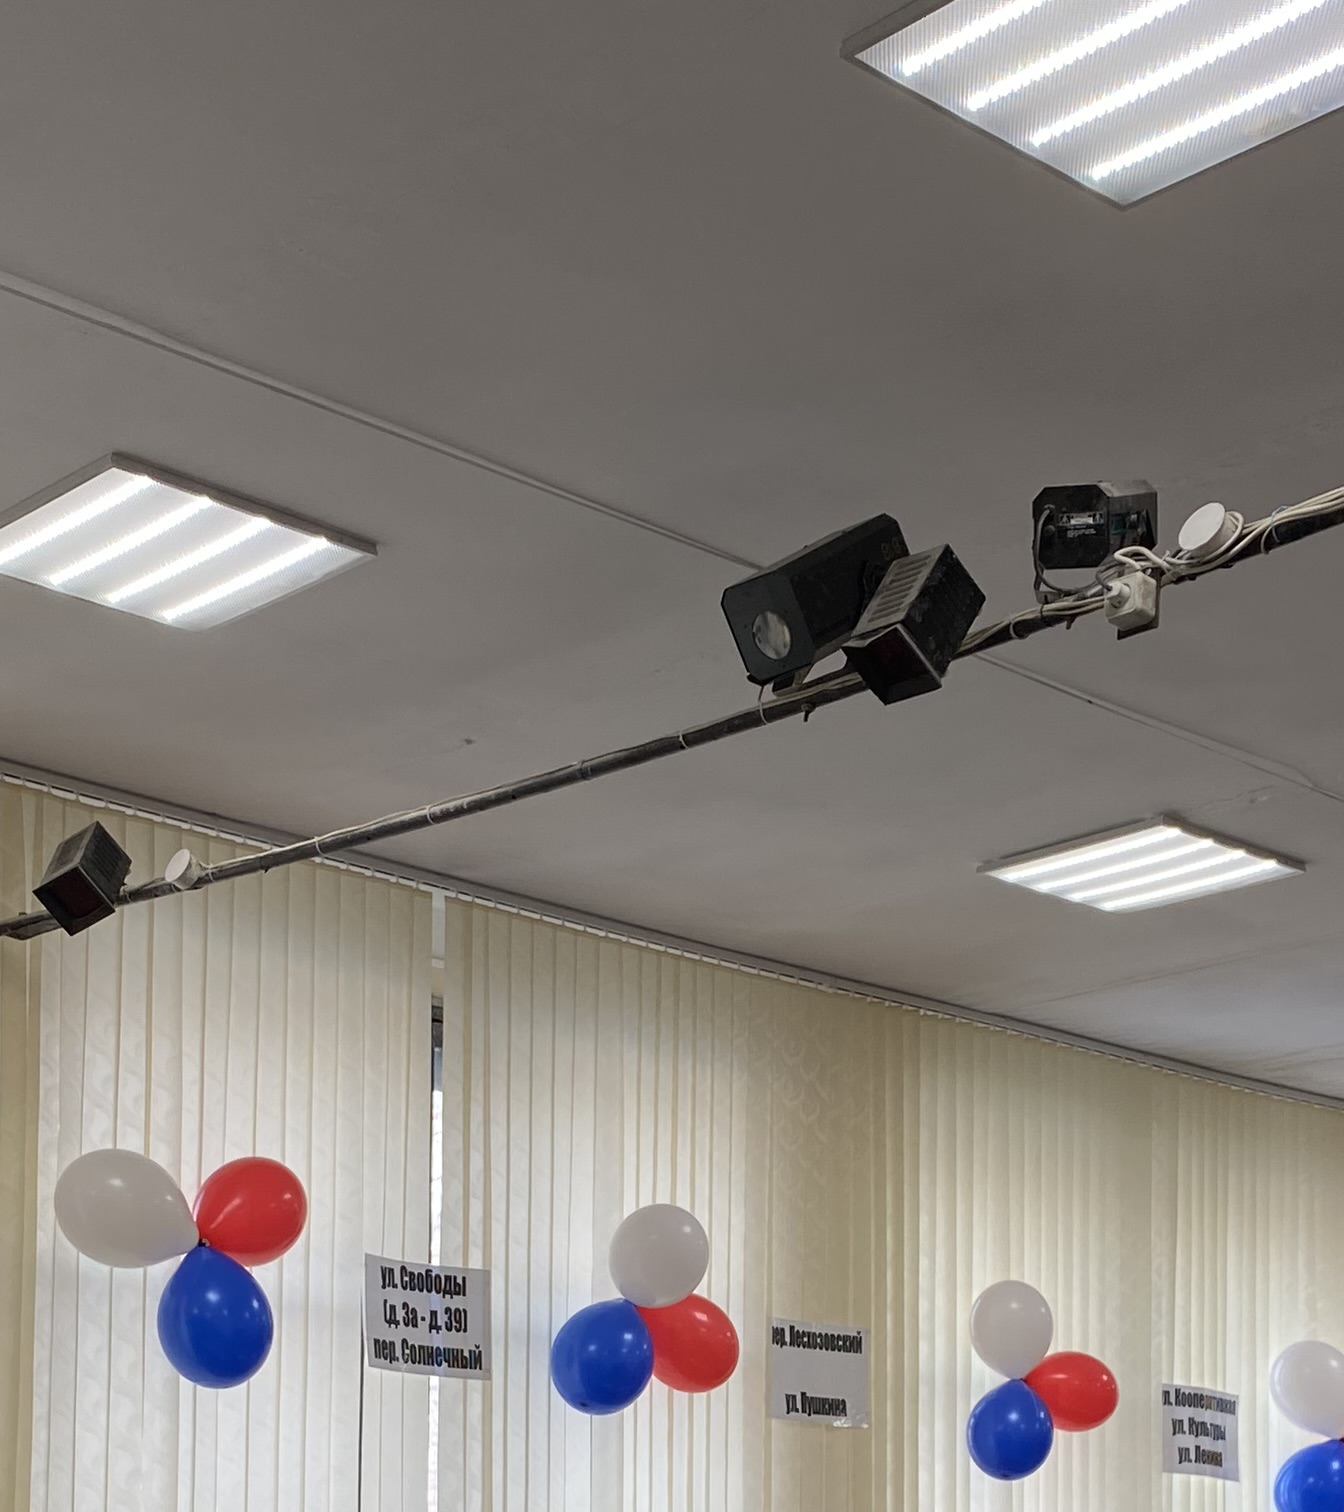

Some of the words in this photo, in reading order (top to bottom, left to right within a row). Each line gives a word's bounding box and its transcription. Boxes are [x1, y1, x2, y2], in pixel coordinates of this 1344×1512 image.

[380, 1265, 398, 1290] ул.
[399, 1265, 467, 1299] Свободы
[428, 1309, 443, 1334] д.
[444, 1306, 468, 1333] 39)
[788, 1324, 863, 1355] Лесхозовский
[373, 1337, 400, 1364] пер.
[400, 1337, 483, 1371] Солнечный
[784, 1393, 800, 1415] ул.
[800, 1391, 848, 1417] Пушкина
[1162, 1390, 1173, 1406] л.
[1171, 1417, 1187, 1436] ул.
[1177, 1446, 1193, 1465] ул.
